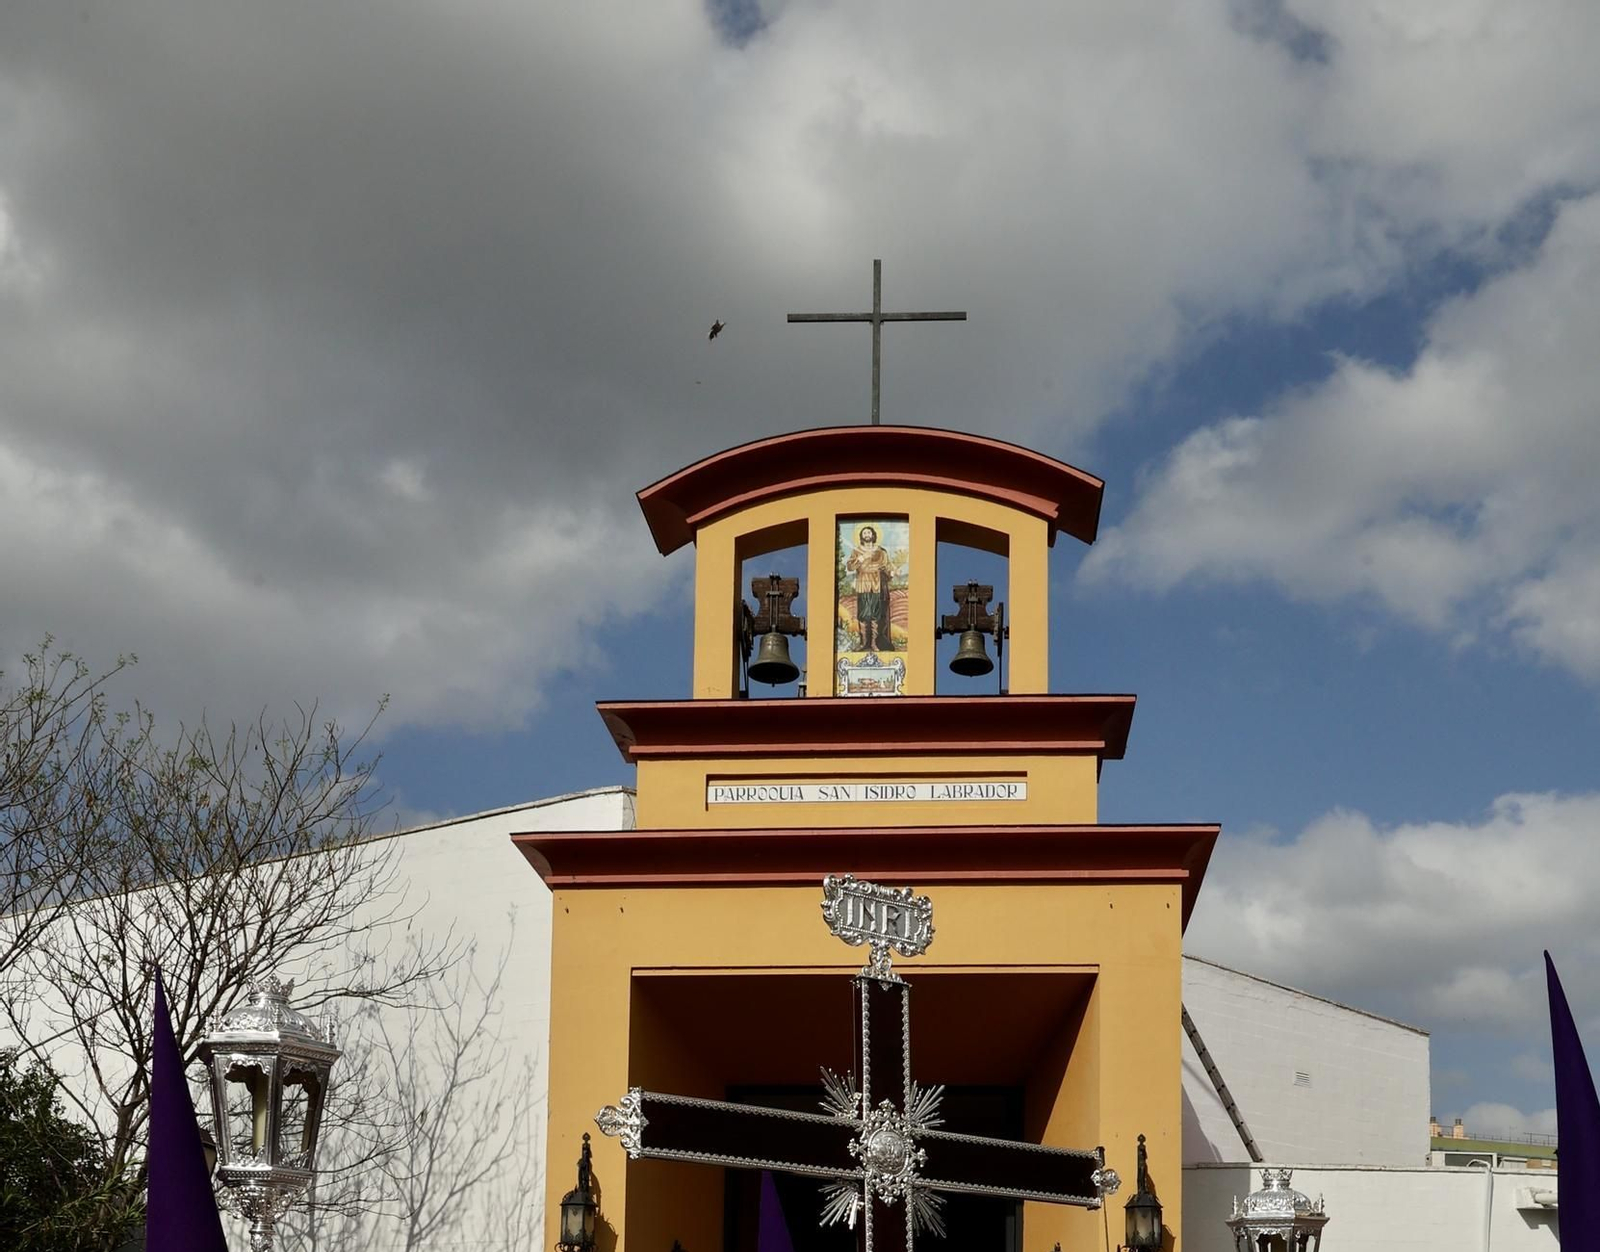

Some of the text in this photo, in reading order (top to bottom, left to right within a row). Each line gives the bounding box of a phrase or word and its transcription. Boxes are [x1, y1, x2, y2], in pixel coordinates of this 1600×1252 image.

[818, 785, 851, 800] SAN
[864, 785, 917, 799] ISIDRO
[930, 784, 1018, 799] LABRADOR
[845, 895, 911, 938] INRI
